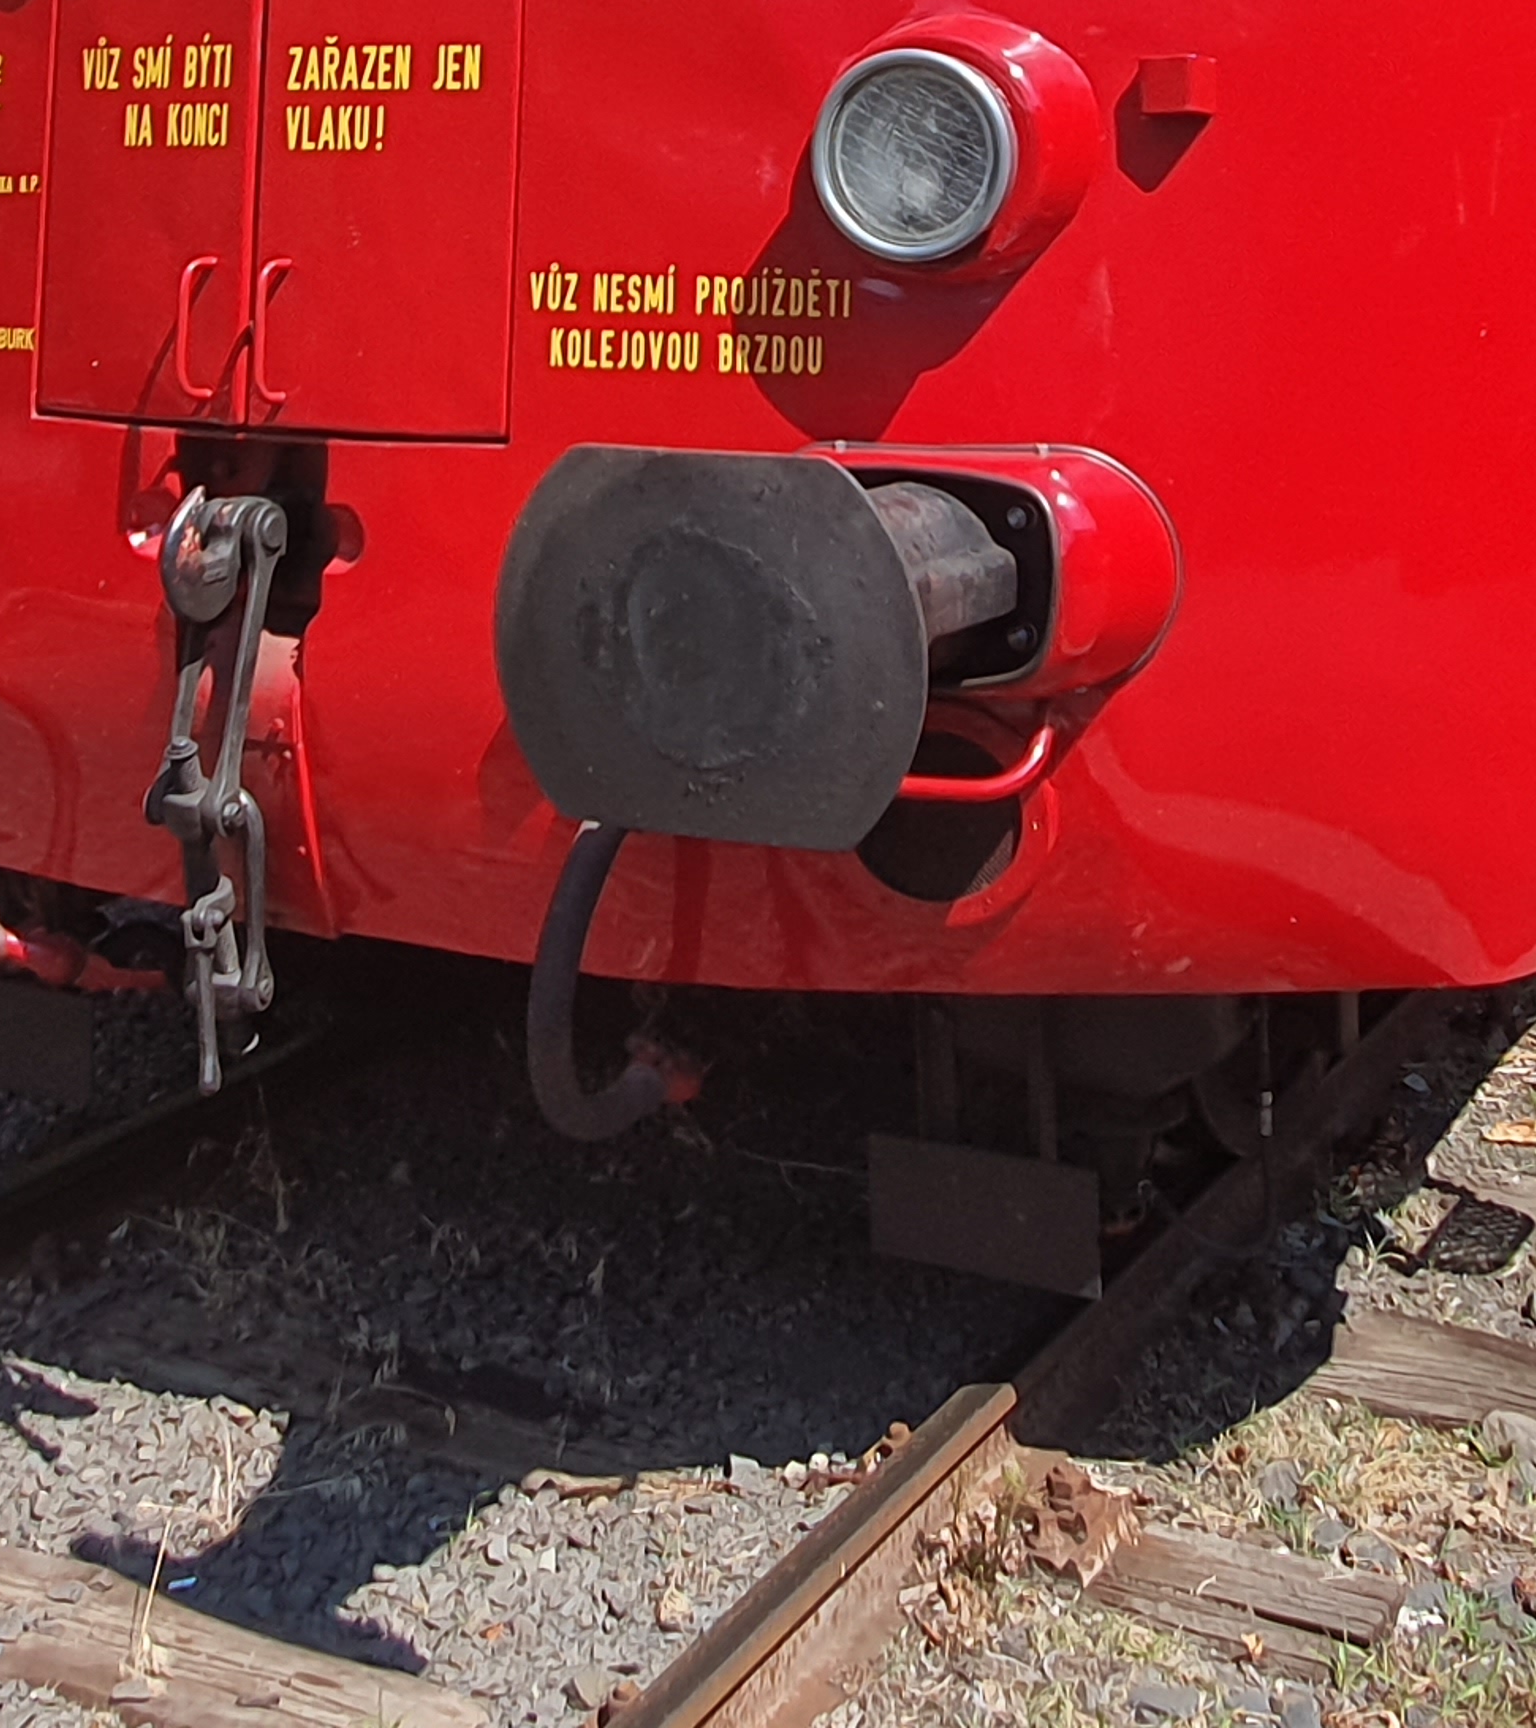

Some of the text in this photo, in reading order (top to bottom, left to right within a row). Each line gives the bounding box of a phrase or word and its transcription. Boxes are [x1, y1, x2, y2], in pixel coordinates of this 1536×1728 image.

[82, 32, 233, 91] VŮZ SMÍ BÝTI
[286, 35, 482, 91] ZAŘAZEN JEN
[123, 102, 229, 148] NA KONCI
[286, 105, 385, 152] VLAKU!
[529, 262, 852, 318] VŮZ NESMÍ PROJÍŽDĚTI
[549, 327, 825, 375] KOLEJOVOU BRZDOU
